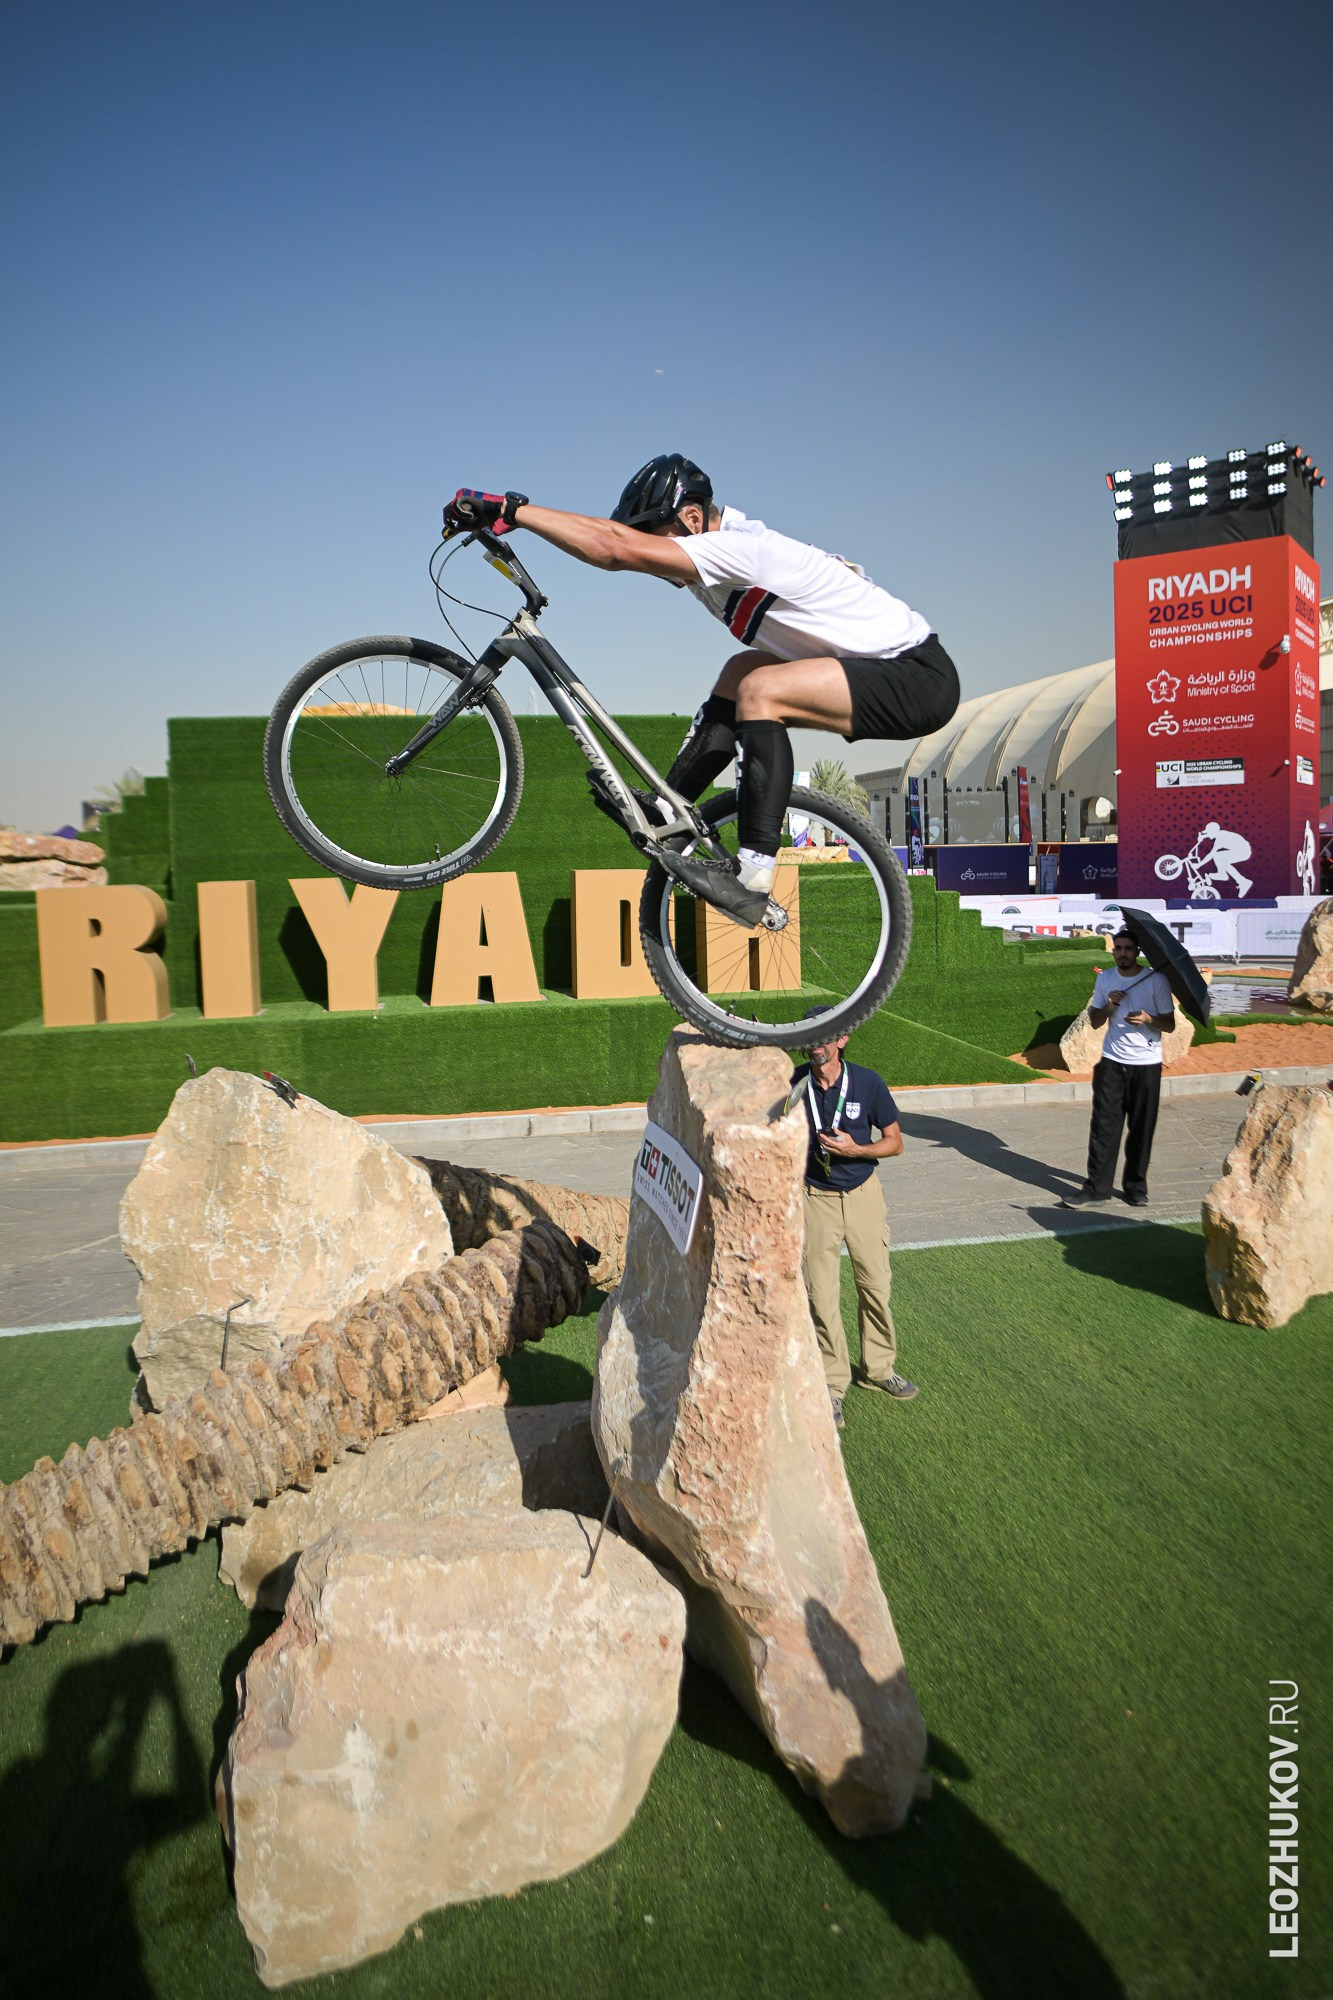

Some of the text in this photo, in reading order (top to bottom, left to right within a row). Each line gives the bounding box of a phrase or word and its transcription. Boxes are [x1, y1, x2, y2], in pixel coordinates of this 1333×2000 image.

[1148, 565, 1251, 602] RIYADH
[1295, 565, 1315, 603] RIYADH
[1149, 595, 1253, 624] 2025 UCI
[1149, 617, 1254, 637] URBAN CYCLING WORLD
[1149, 628, 1253, 649] CHAMPIONSHIPS
[1187, 668, 1256, 685] وزارة الرياضة
[1187, 683, 1256, 698] Ministry of Sport
[1182, 714, 1255, 727] SAUDI CYCLING
[1161, 763, 1182, 772] UCI
[659, 1152, 695, 1222] TISSOT
